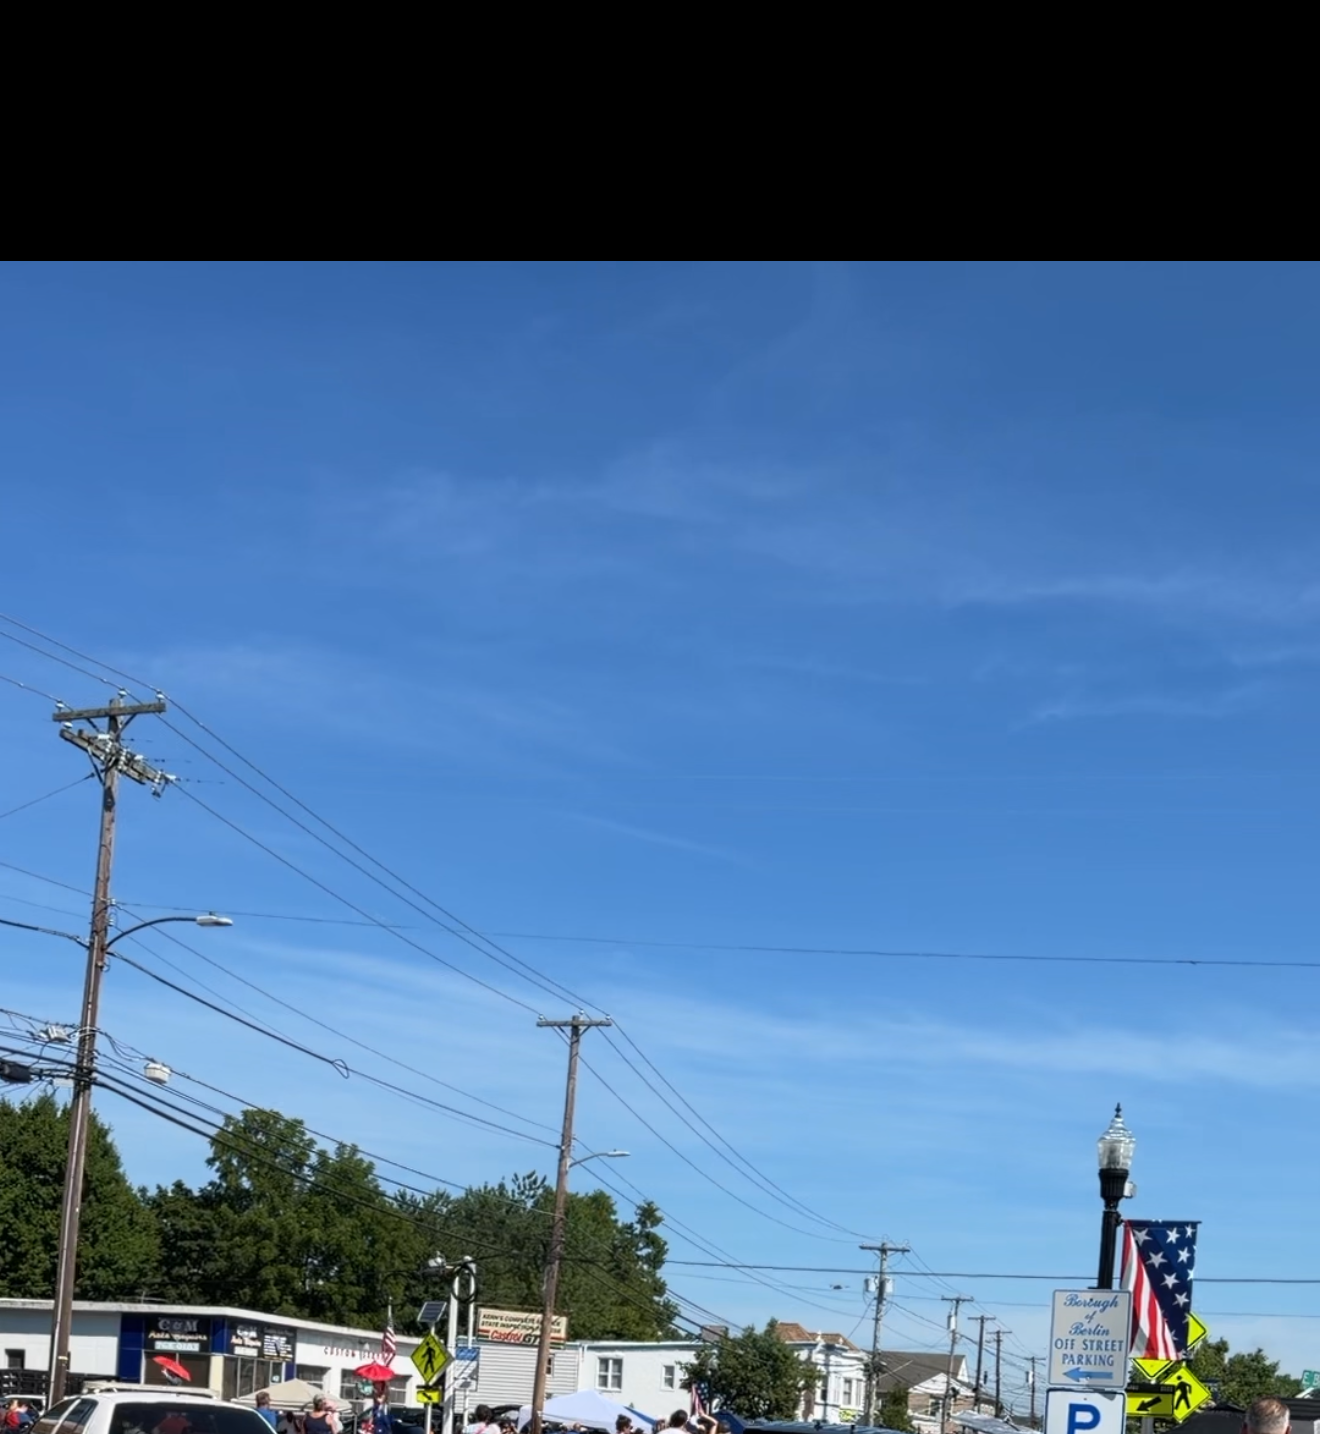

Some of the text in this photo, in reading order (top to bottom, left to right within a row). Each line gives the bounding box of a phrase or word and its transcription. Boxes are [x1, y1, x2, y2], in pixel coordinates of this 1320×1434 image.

[1063, 1293, 1118, 1312] Borough
[1084, 1310, 1097, 1324] of
[158, 1319, 170, 1330] C
[184, 1320, 198, 1332] M
[1068, 1321, 1110, 1336] Berlin
[148, 1330, 170, 1339] Auto
[490, 1330, 541, 1345] Castrol GT
[323, 1346, 356, 1358] CUSTOM
[1054, 1338, 1124, 1352] OFF STREET
[1061, 1353, 1115, 1367] PARKING
[1302, 1371, 1310, 1385] E
